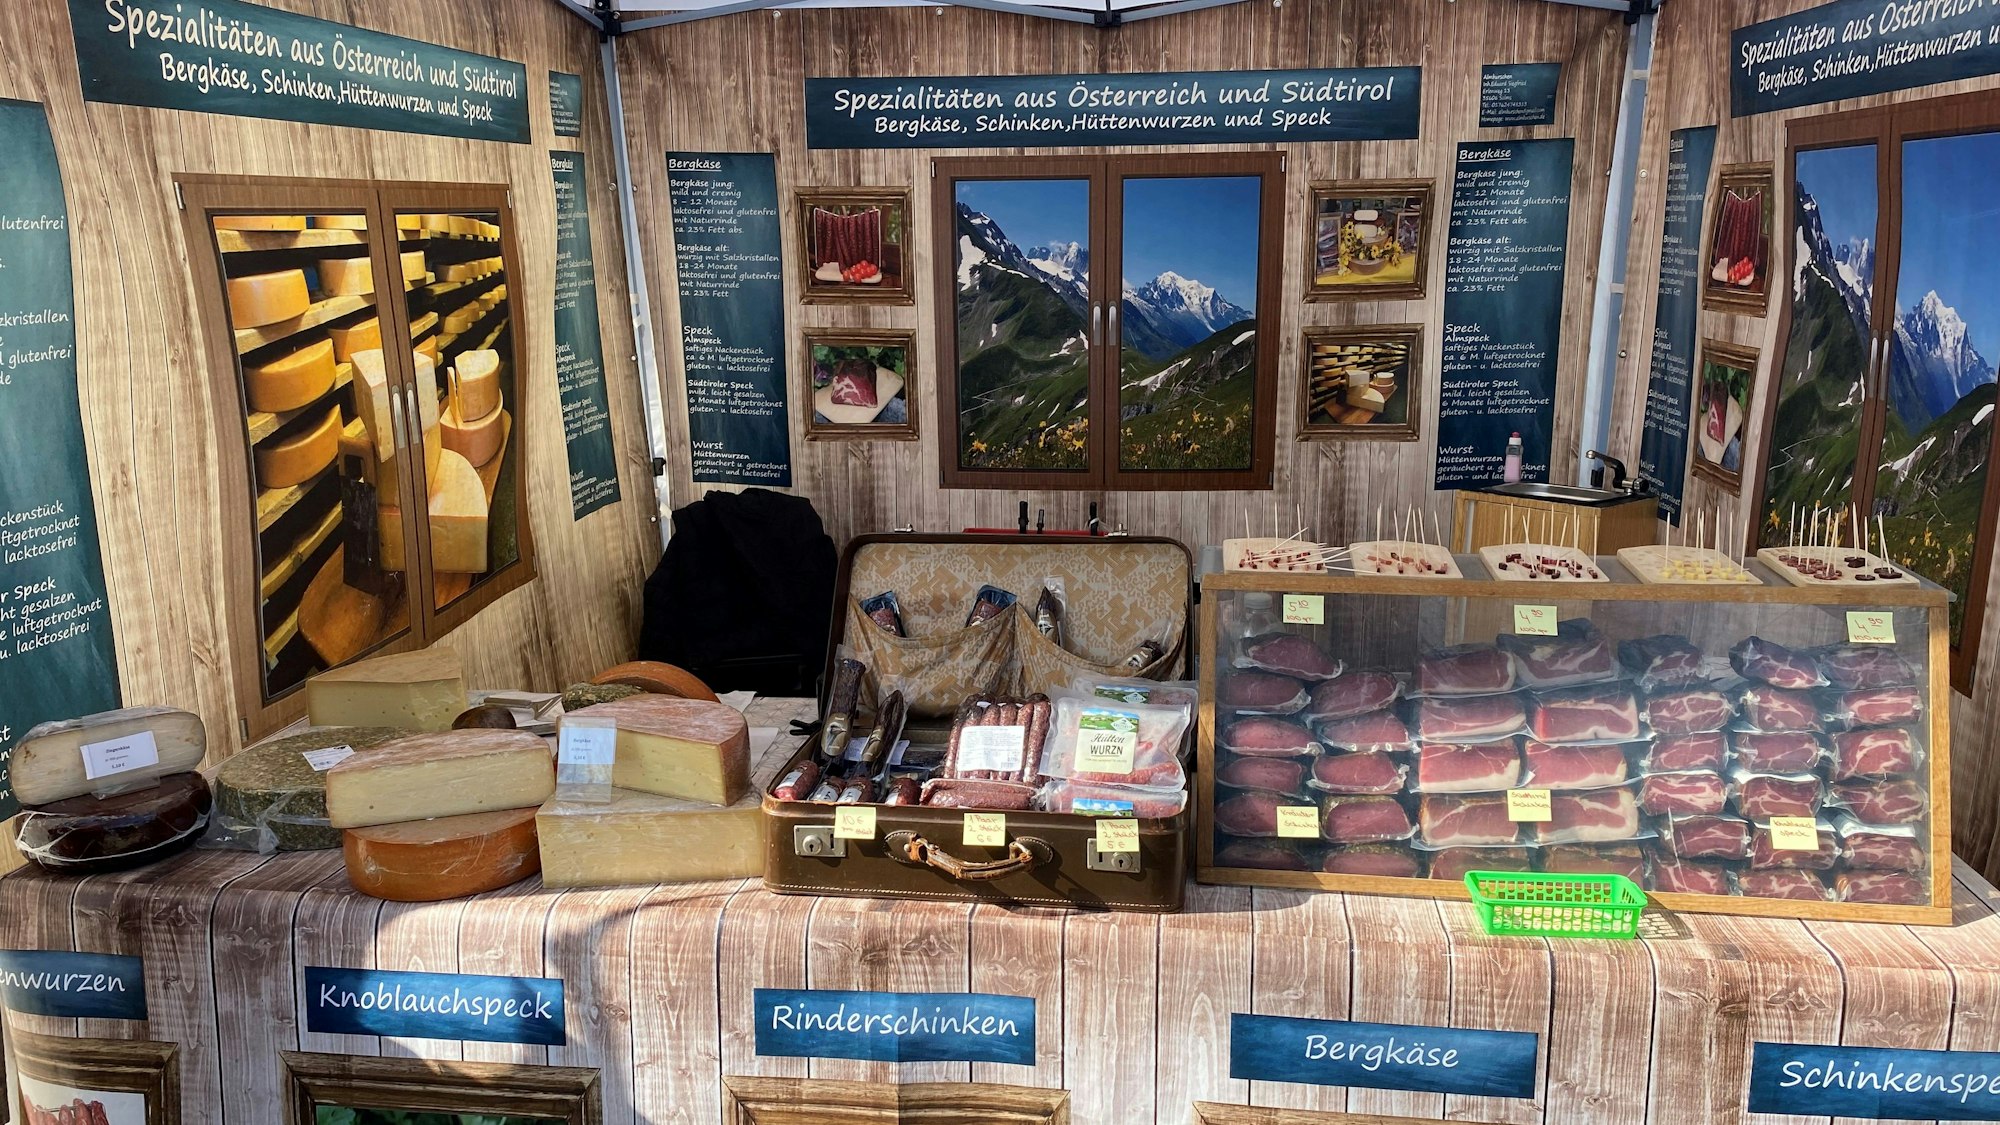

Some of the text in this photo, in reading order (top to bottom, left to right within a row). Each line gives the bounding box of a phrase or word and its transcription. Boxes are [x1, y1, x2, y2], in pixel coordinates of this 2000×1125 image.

[105, 0, 517, 99] Spezialitäten aus Österreich und Südtirol
[1741, 24, 1836, 76] Spezialitäten
[1842, 13, 1875, 43] aus
[1758, 65, 1808, 96] Bergkäse,
[159, 53, 257, 94] Bergkäse,
[437, 96, 460, 118] und
[462, 99, 493, 126] Speck
[834, 76, 1394, 119] Spezialitäten aus Österreich und Südtirol
[874, 115, 968, 137] Bergkäse,
[1224, 109, 1263, 127] und
[1271, 107, 1332, 131] Speck
[1459, 148, 1511, 160] Bergkäse
[669, 158, 722, 170] Bergkäse
[1457, 169, 1524, 180] Bergkäse jung:
[670, 179, 735, 189] Bergkäse jung:
[1456, 179, 1530, 188] mild und cremig
[671, 188, 742, 199] mild und cremig
[1454, 198, 1498, 207] laktosefrei
[1523, 196, 1568, 206] glutenfrei
[673, 207, 777, 217] laktosefrei und glutenfrei
[1471, 207, 1523, 215] Naturrinde
[690, 217, 738, 225] Naturrinde
[1490, 217, 1509, 225] Fett
[708, 226, 725, 234] Fett
[1449, 236, 1512, 247] Bergkäse alt:
[677, 244, 730, 253] Bergkäse alt:
[1503, 245, 1563, 254] Salzkristallen
[722, 254, 780, 262] Salzkristallen
[707, 263, 738, 271] Monate
[1447, 263, 1562, 274] laktosefrei und glutenfrei
[679, 271, 718, 279] laktosefrei
[739, 271, 781, 281] glutenfrei
[1467, 274, 1519, 282] Naturrinde
[696, 281, 740, 289] Naturrinde
[1486, 284, 1505, 292] Fett
[712, 290, 730, 298] Fett
[684, 325, 713, 336] Speck
[1445, 323, 1481, 334] Speck
[684, 336, 722, 345] Almspeck
[1444, 334, 1490, 343] Almspeck
[685, 345, 713, 353] saftiges
[1443, 344, 1478, 352] saftiges
[9, 345, 72, 369] glutenfrei
[718, 355, 774, 364] luftgetrocknet
[1483, 352, 1546, 361] luftgetrocknet
[686, 363, 771, 372] gluten- lacktosefrei
[1443, 360, 1541, 372] gluten- lacktosefrei
[688, 379, 754, 391] Südtiroler Speck
[1442, 378, 1519, 389] Südtiroler Speck
[734, 391, 765, 399] gesalzen
[1468, 388, 1530, 399] leicht gesalzen
[728, 398, 783, 408] luftgetrocknet
[1487, 397, 1550, 406] luftgetrocknet
[730, 406, 773, 415] lacktosefrei
[1440, 405, 1537, 418] gluten- lacktosefrei
[693, 440, 724, 450] Wurst
[1439, 445, 1474, 454] Wurst
[693, 450, 750, 460] Hüttenwurzen
[1438, 455, 1503, 463] Hüttenwurzen
[746, 462, 788, 470] getrocknet
[726, 468, 781, 478] und lactosefrei
[1436, 473, 1469, 482] gluten-
[1471, 472, 1488, 480] und
[5, 532, 77, 564] lacktosefrei
[14, 576, 56, 601] Speck
[20, 591, 76, 619] gesalzen
[13, 598, 102, 637] luftgetrocknet
[16, 618, 90, 655] lacktosefrei
[1090, 745, 1123, 755] WURZN
[320, 982, 553, 1025] Knoblauchspeck
[772, 1002, 1018, 1036] Rinderschinken
[1304, 1034, 1459, 1071] Bergkäse
